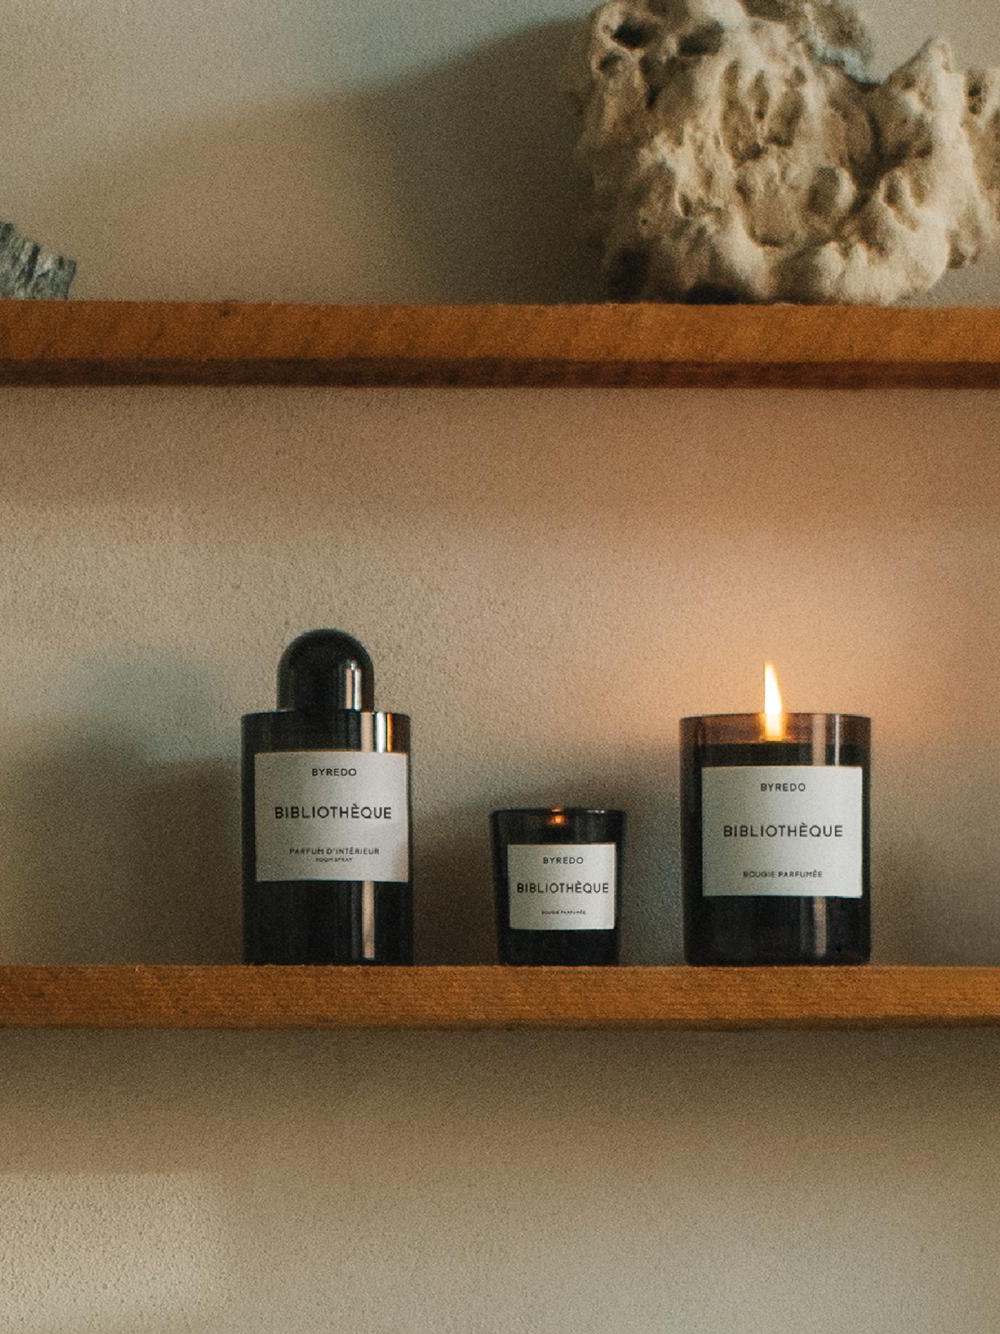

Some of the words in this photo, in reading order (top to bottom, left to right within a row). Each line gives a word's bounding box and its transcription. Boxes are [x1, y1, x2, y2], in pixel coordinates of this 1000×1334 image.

[312, 768, 357, 777] BYREDO
[760, 783, 806, 792] BYREDO
[275, 803, 392, 819] BIBLIOTHÈQUE
[723, 822, 843, 837] BIBLIOTHÈQUE
[543, 856, 584, 864] BYREDO
[517, 880, 609, 894] BIBLIOTHÈQUE
